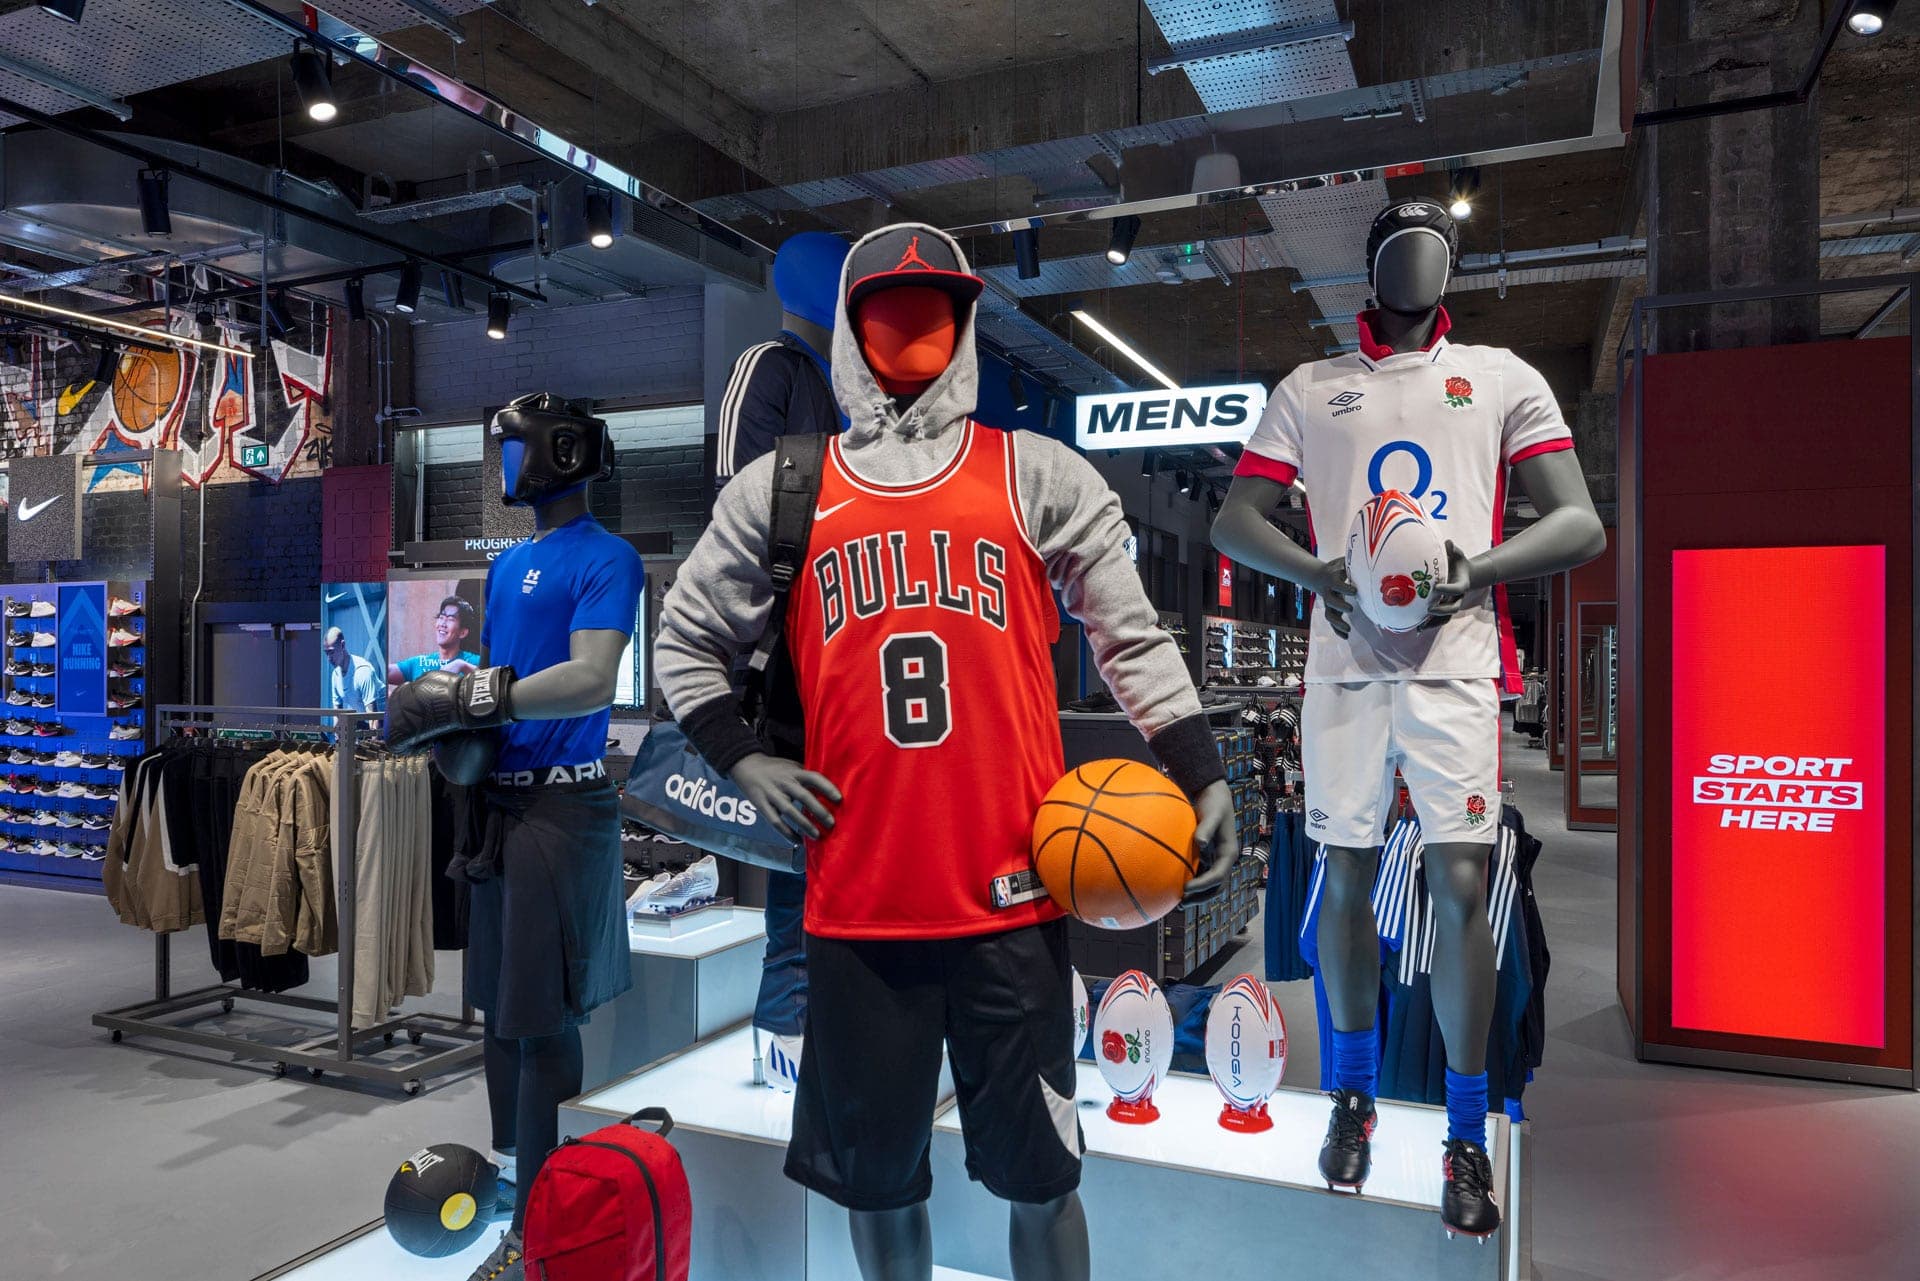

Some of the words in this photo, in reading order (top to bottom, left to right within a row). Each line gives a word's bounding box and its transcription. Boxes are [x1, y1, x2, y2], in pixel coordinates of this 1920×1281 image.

[1087, 394, 1250, 434] MENS
[1332, 405, 1362, 417] umbro
[813, 530, 1007, 646] BULLS
[63, 657, 101, 670] RUNNING
[879, 631, 952, 749] 8
[1706, 754, 1853, 777] SPORT
[665, 773, 758, 826] adidas
[1696, 781, 1858, 805] STARTS
[1720, 809, 1835, 832] HERE
[1232, 1006, 1242, 1088] KOOGA
